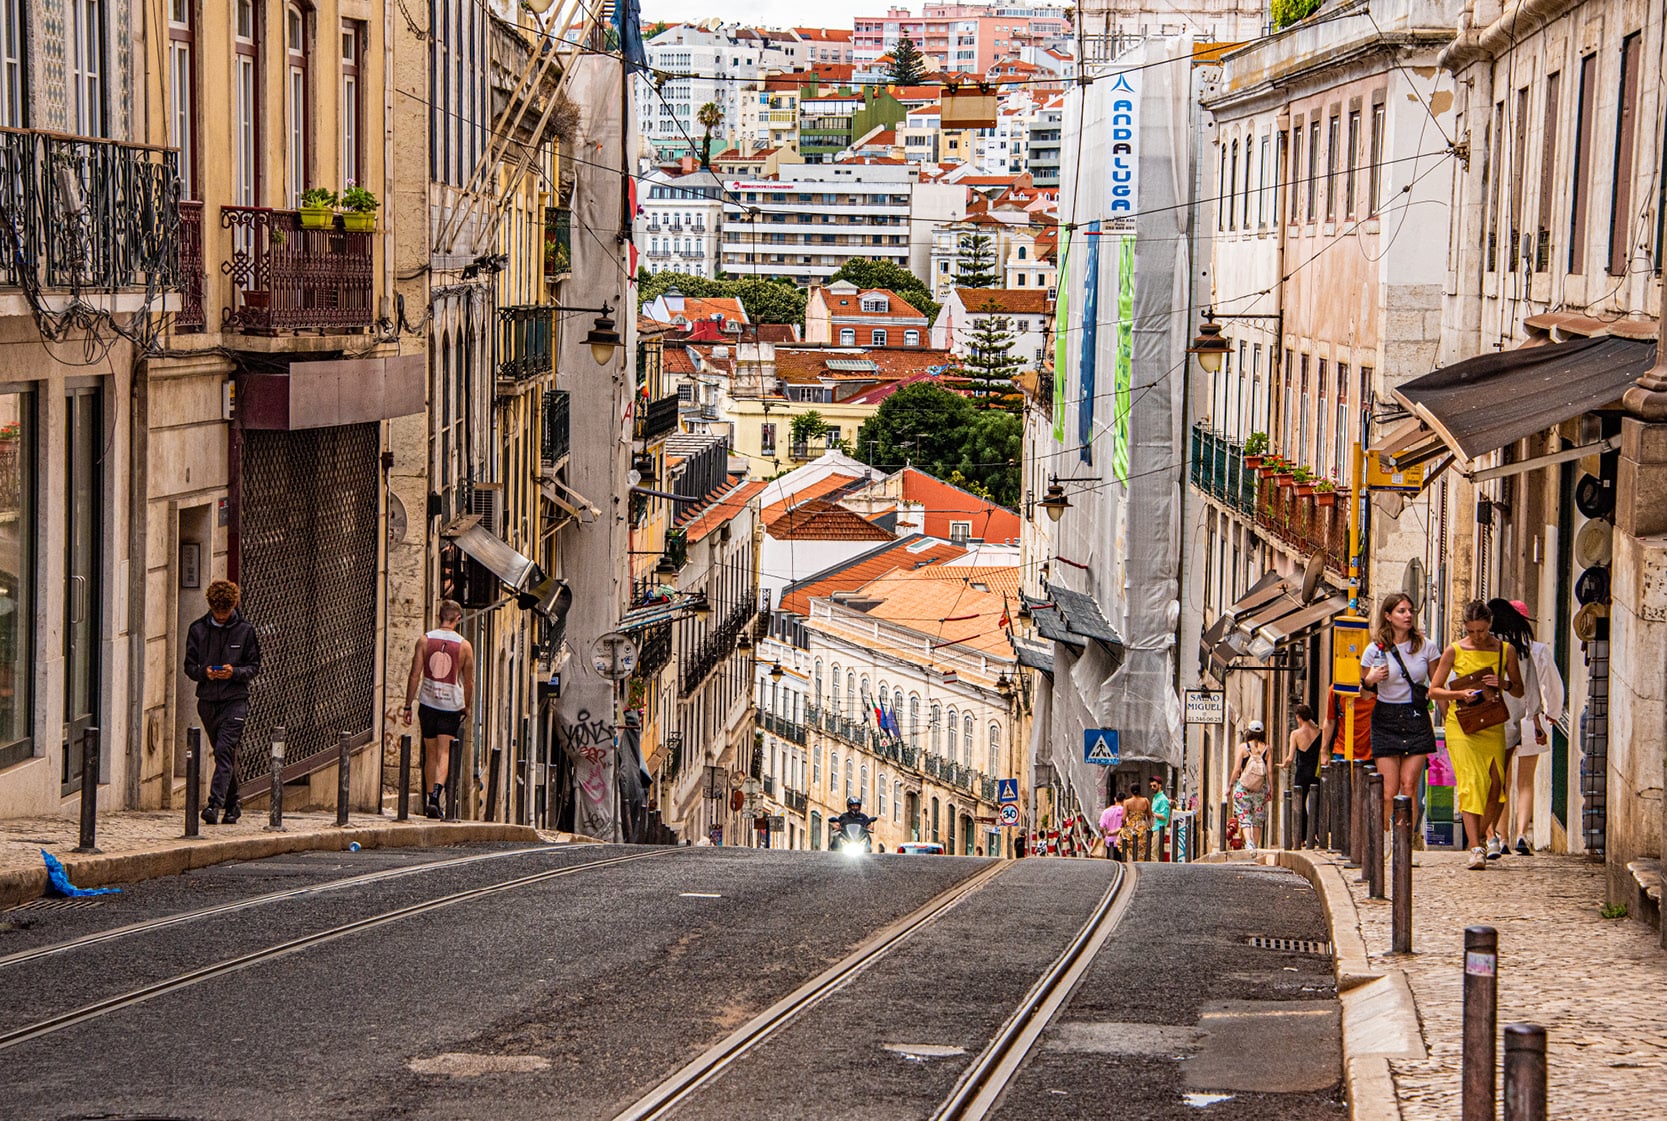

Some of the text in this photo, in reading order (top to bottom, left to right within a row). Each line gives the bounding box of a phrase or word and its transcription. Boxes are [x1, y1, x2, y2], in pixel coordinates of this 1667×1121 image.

[1111, 99, 1133, 211] ANDALUGA
[1187, 703, 1222, 711] MIGUEL
[1002, 809, 1017, 819] 30
